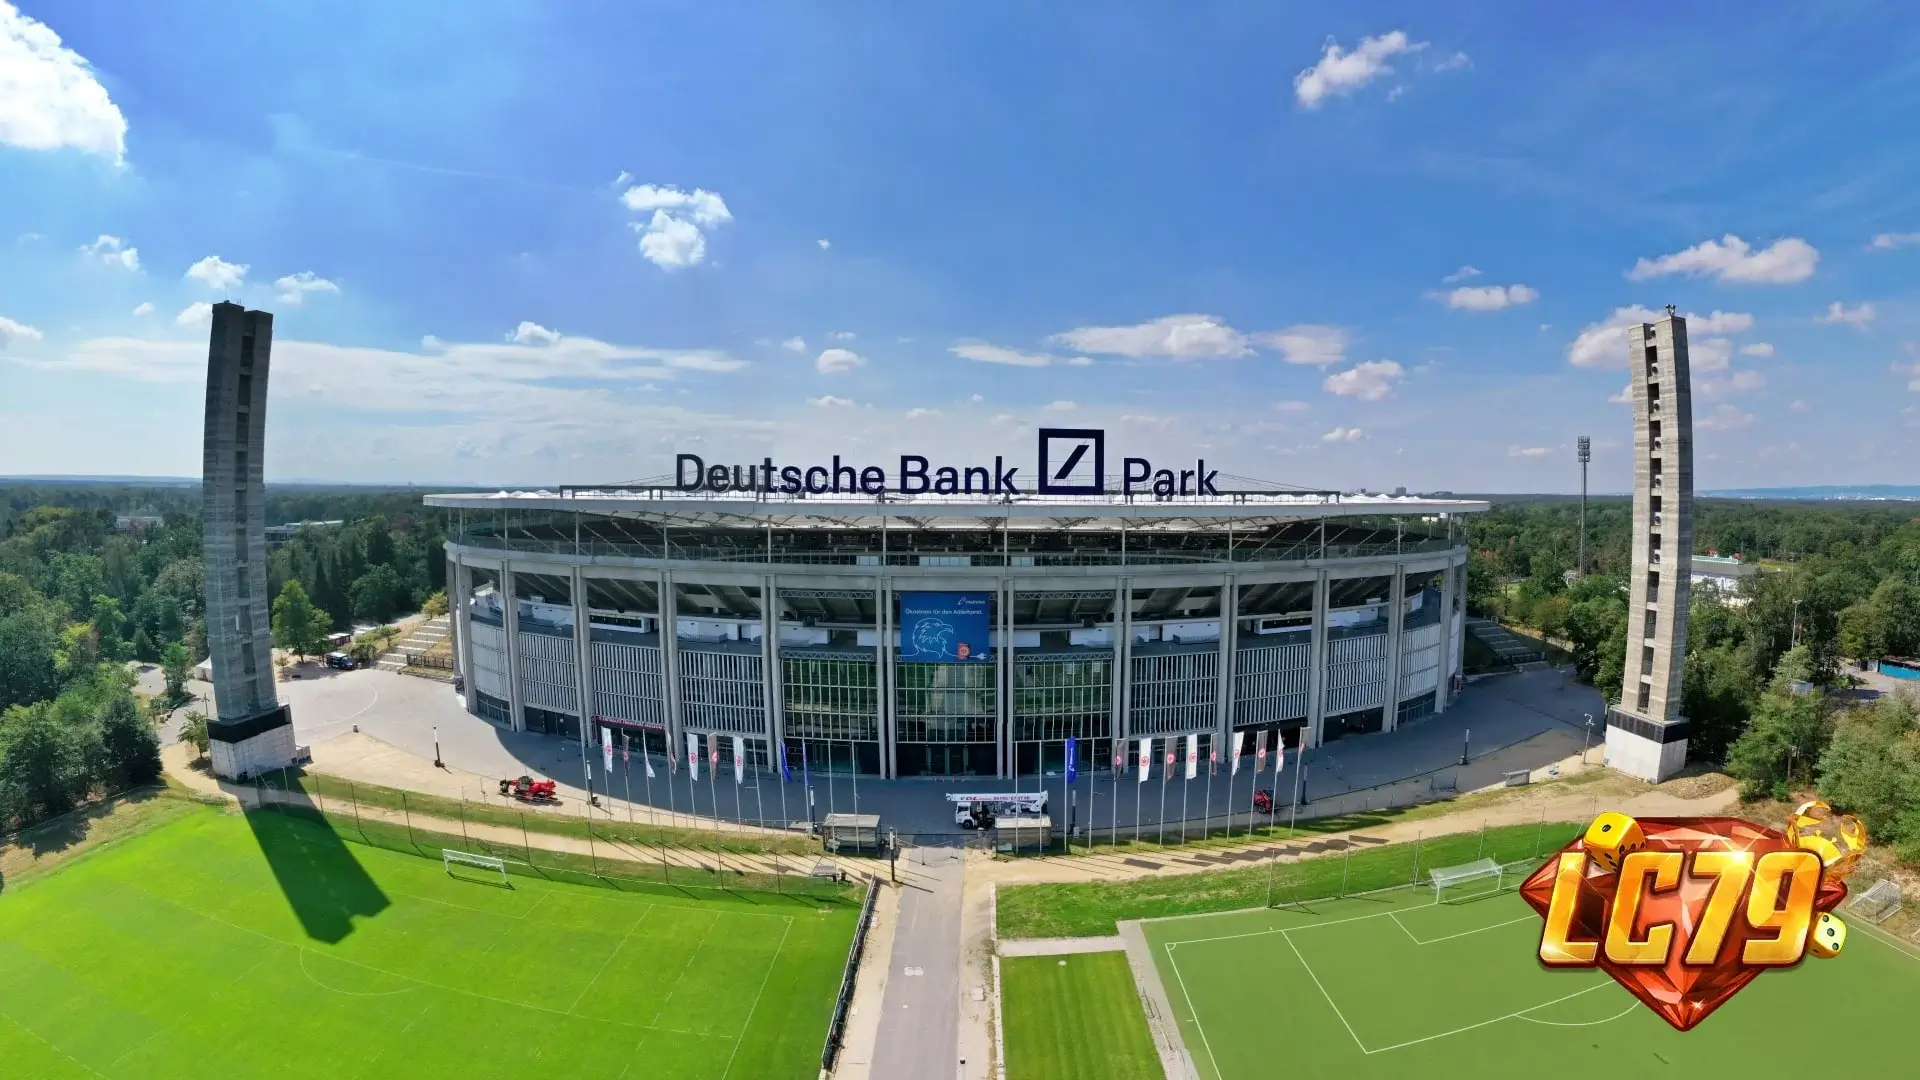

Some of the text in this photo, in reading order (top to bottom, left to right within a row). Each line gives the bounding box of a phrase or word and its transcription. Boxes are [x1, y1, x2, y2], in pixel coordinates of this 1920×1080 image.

[676, 453, 1219, 497] Deutsche Bank Park
